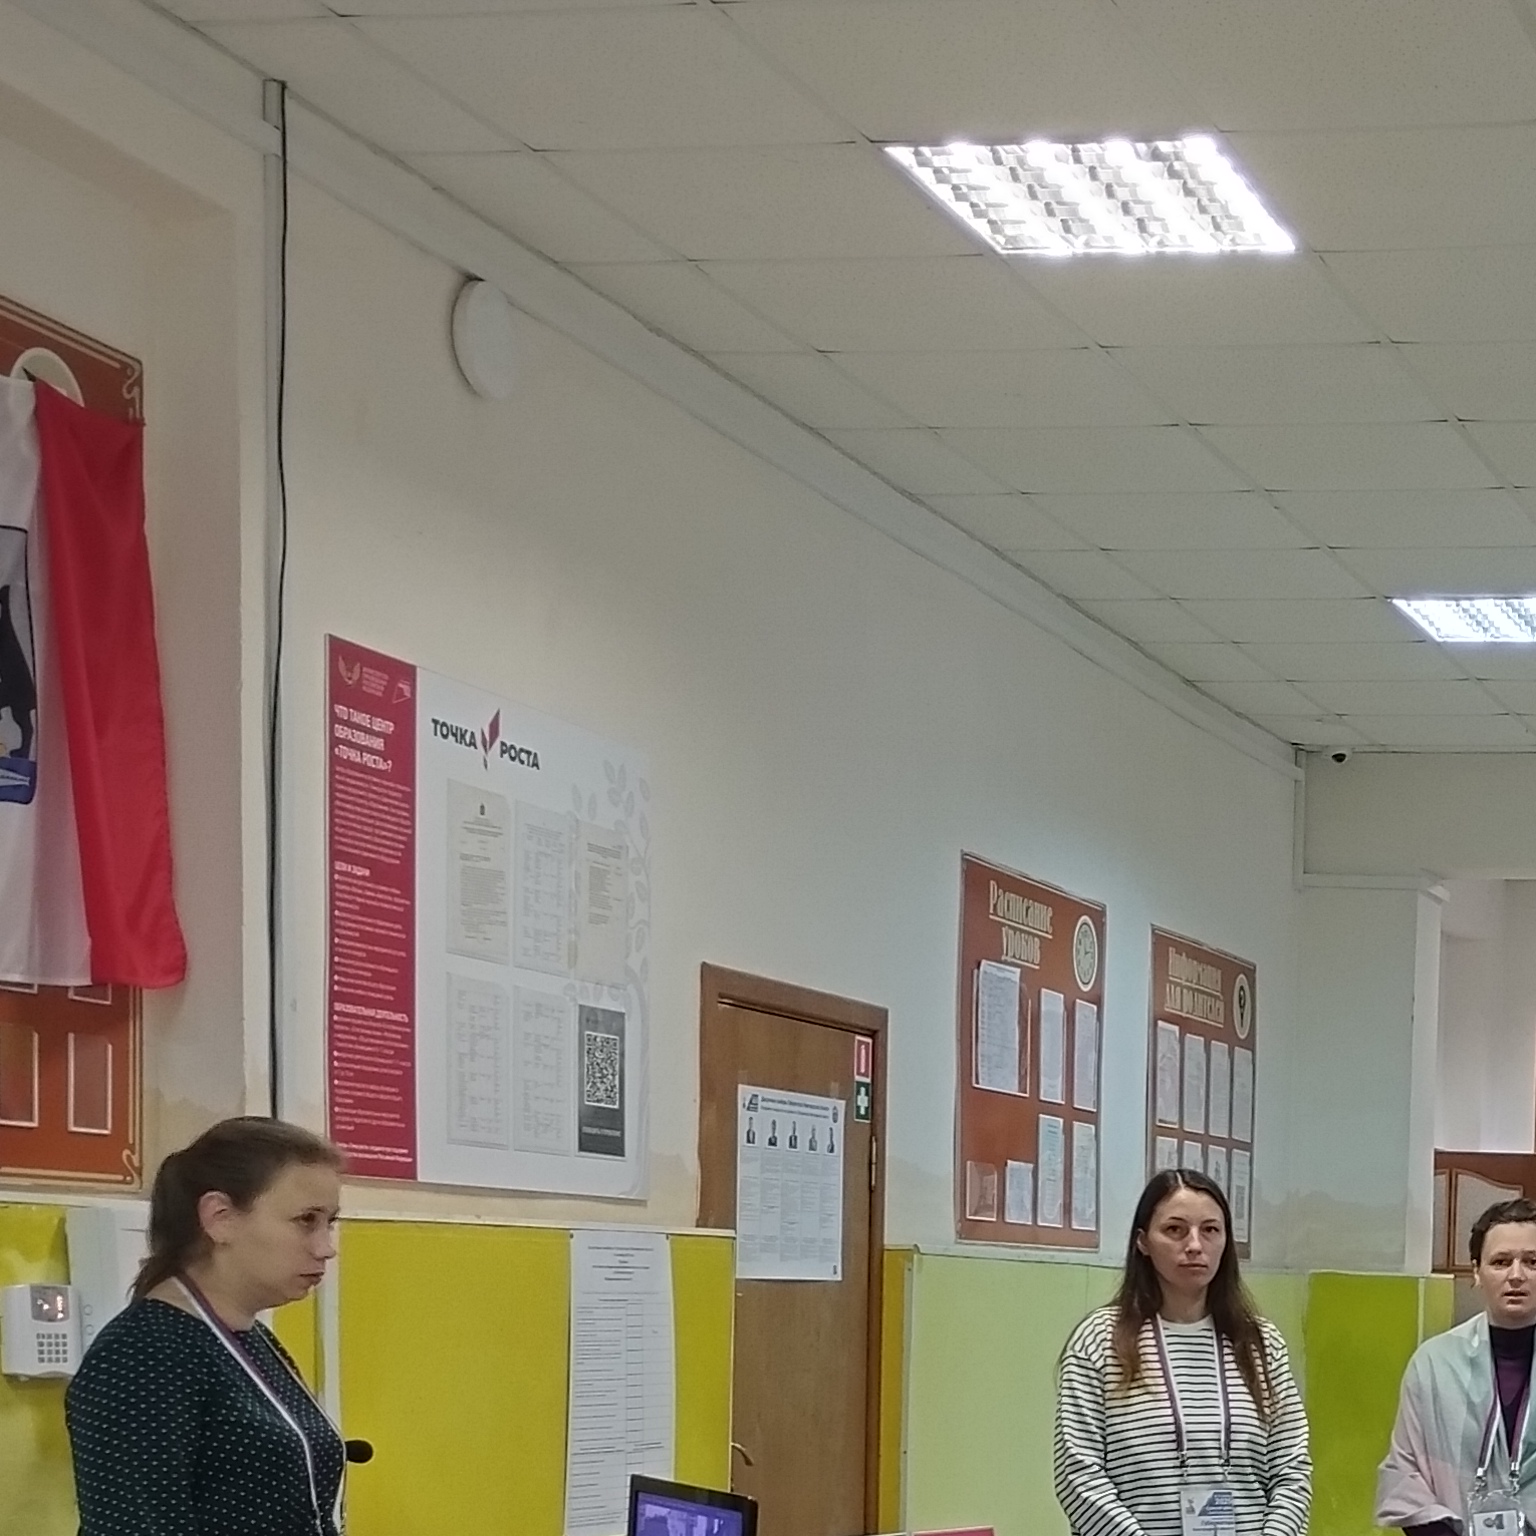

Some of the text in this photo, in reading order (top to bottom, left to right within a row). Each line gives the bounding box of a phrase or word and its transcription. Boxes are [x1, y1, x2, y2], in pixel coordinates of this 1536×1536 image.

[431, 718, 478, 750] ТОЧКА
[500, 741, 540, 770] РОСТА
[989, 880, 1052, 933] Расписание
